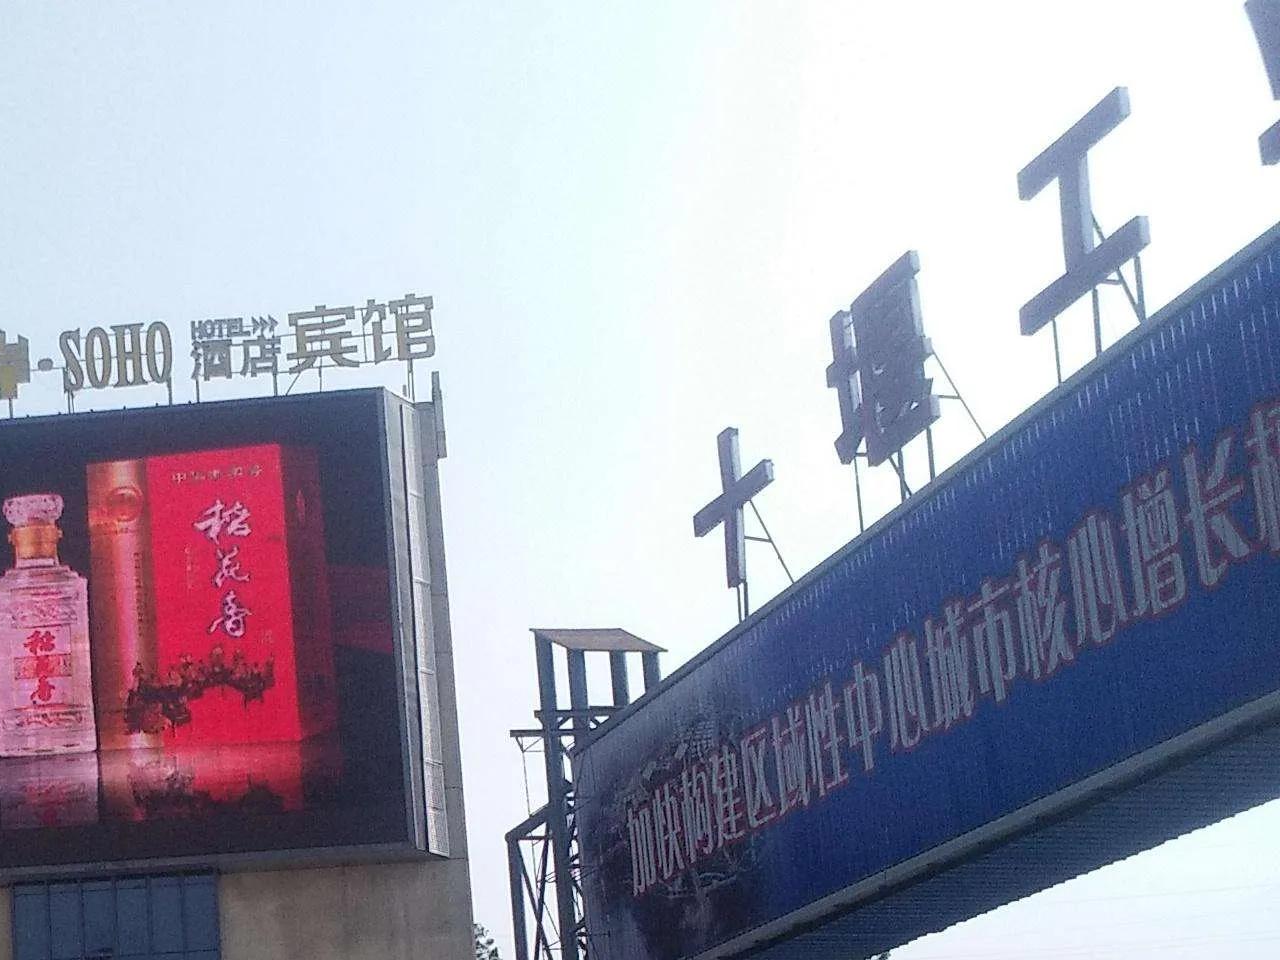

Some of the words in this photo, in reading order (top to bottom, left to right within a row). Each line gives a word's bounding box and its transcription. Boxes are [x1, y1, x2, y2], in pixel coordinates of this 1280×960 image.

[191, 317, 251, 340] HOTEL
[191, 335, 281, 381] 酒店
[287, 293, 436, 374] 宾馆
